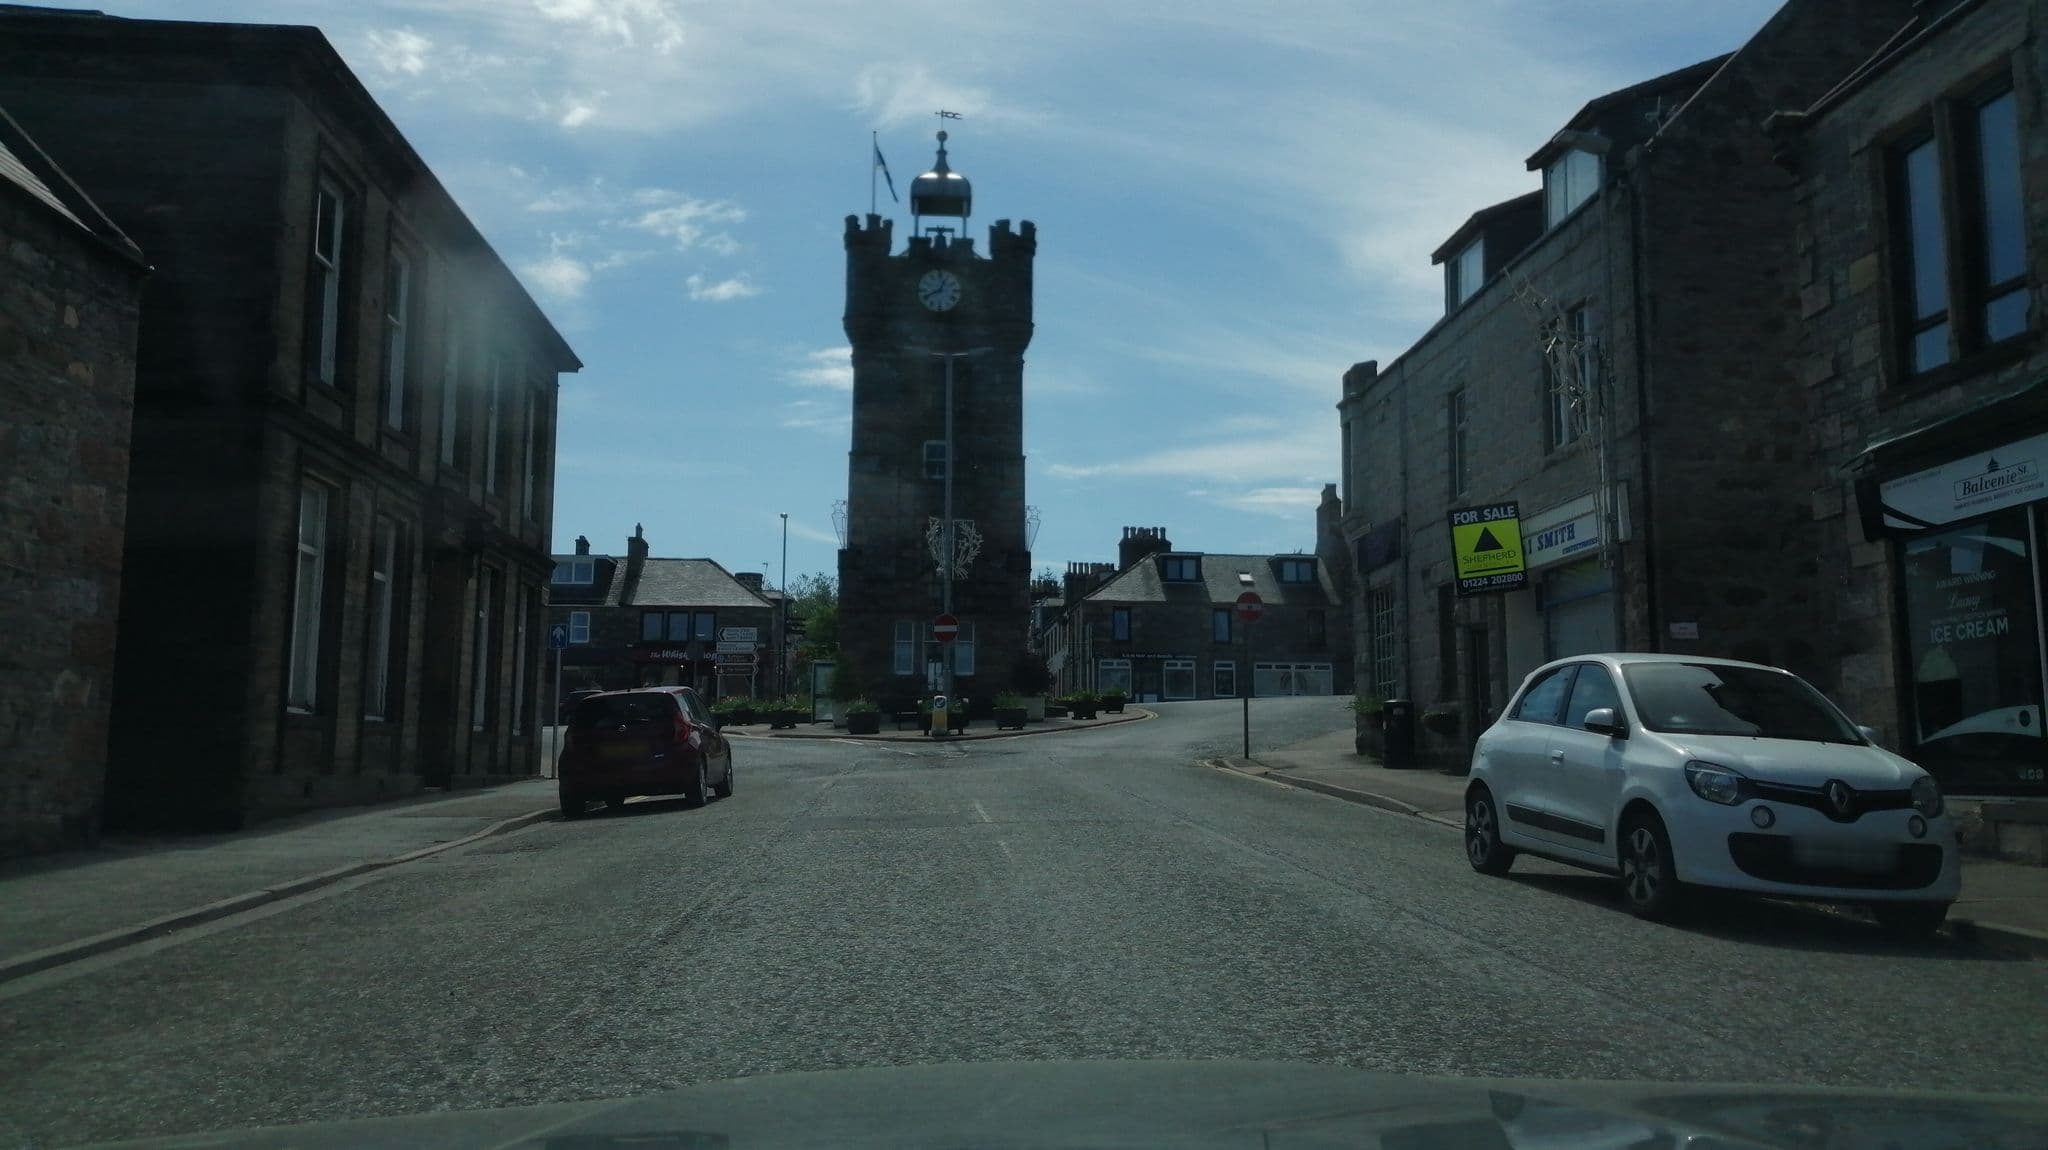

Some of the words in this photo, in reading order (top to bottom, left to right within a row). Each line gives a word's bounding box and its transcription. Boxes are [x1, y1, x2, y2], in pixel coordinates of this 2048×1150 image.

[1962, 470, 2017, 496] Balvenie
[1453, 510, 1479, 525] FOR
[1483, 505, 1516, 521] SALE
[1537, 522, 1576, 551] SMITH
[1462, 550, 1516, 565] SHEPHERD
[1462, 577, 1489, 588] 01224
[1491, 573, 1524, 585] 202800
[1929, 625, 1952, 643] ICE
[1956, 617, 2009, 641] CREAM
[662, 648, 689, 661] Whisk
